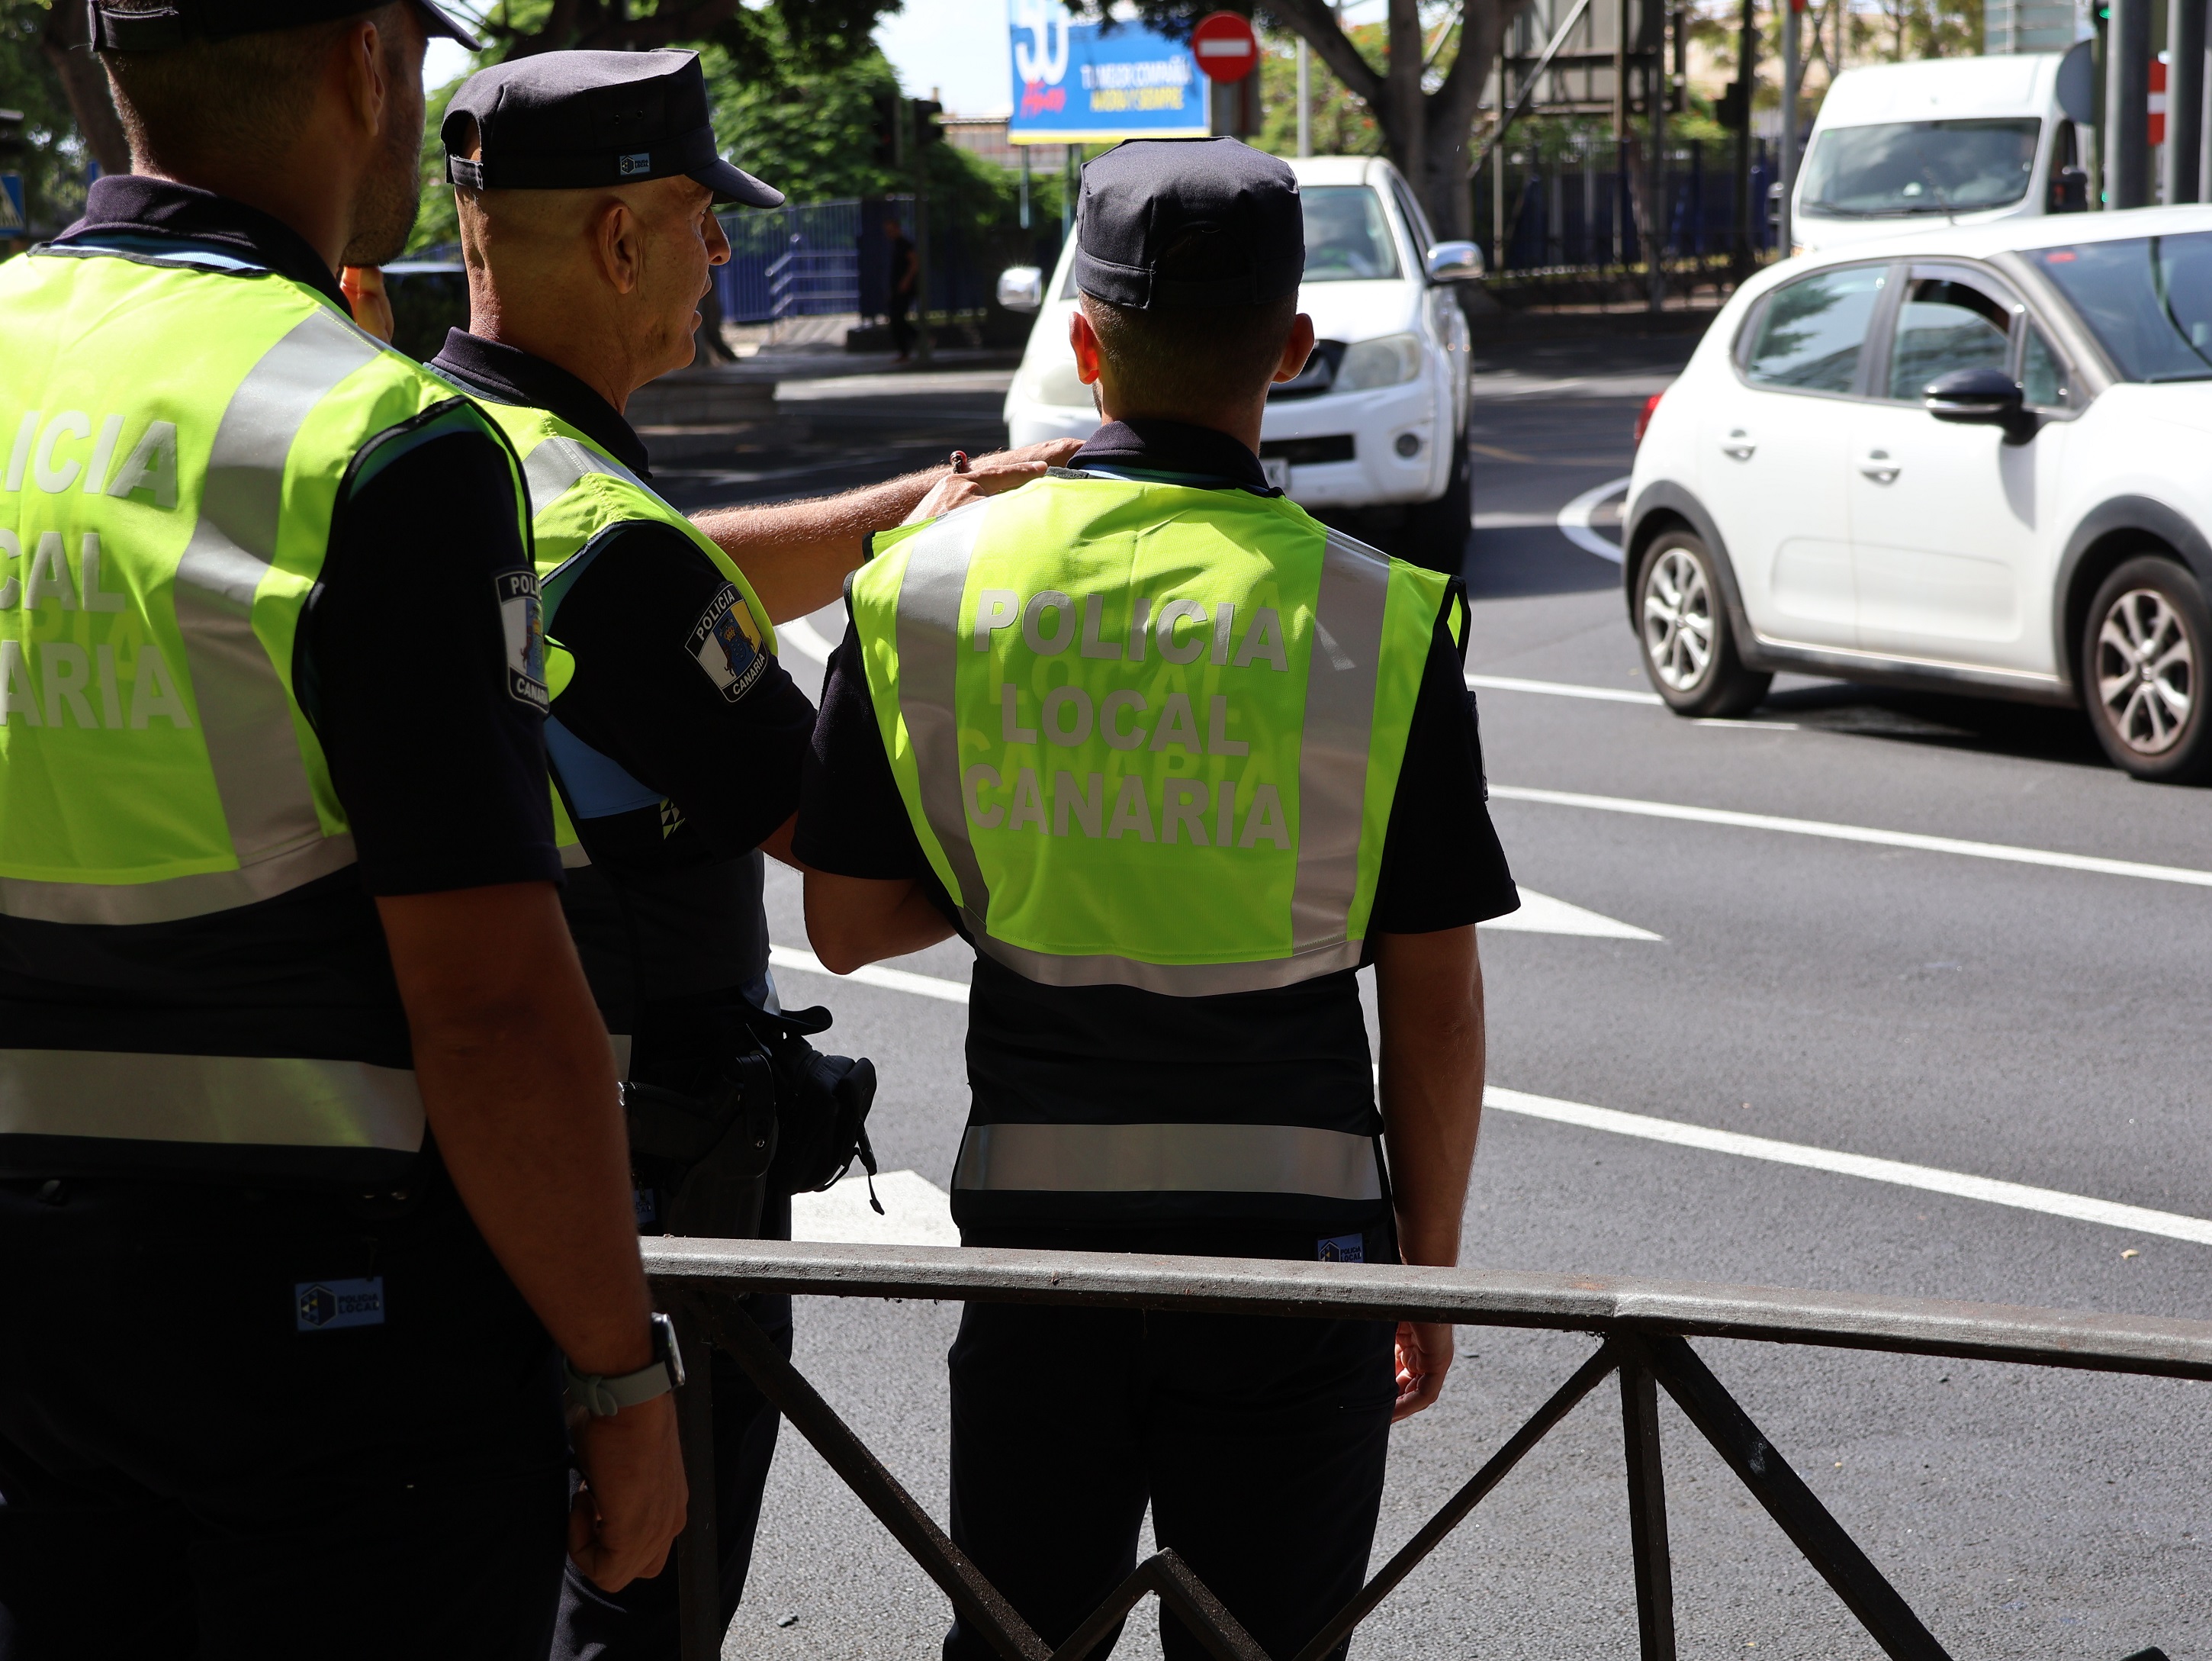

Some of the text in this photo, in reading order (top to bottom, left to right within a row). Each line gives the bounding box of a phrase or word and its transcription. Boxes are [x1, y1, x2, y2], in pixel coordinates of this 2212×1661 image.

[0, 410, 178, 510] ICIA
[696, 590, 735, 642] POLICIA
[973, 590, 1289, 672] POLICIA
[0, 639, 195, 730] ARIA
[732, 652, 766, 695] CANARIA
[1000, 683, 1249, 757] LOCAL
[963, 763, 1292, 851] CANARIA
[339, 1302, 380, 1314] LOCAL
